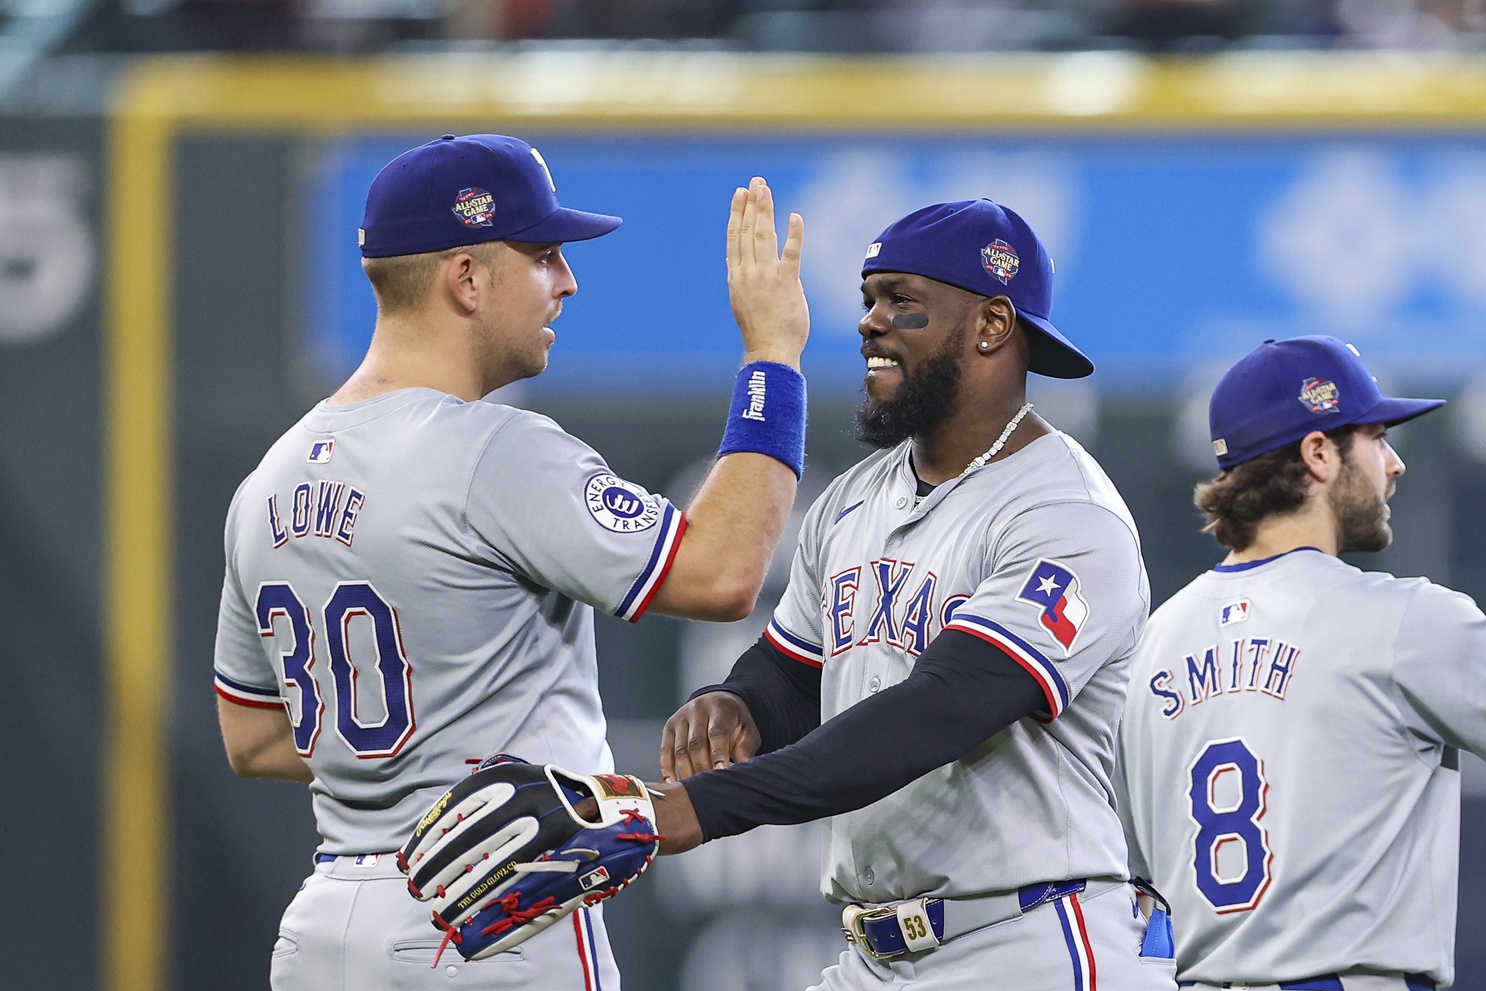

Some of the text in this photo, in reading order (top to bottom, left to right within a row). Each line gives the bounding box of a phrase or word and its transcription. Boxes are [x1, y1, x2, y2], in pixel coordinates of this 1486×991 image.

[463, 204, 489, 217] GAME
[990, 256, 1013, 271] GAME
[742, 370, 766, 422] Franklin
[266, 479, 365, 549] LOWE
[820, 557, 973, 658] EXA
[253, 579, 416, 759] 30
[1148, 635, 1301, 721] SMITH
[1185, 735, 1274, 915] 8
[469, 882, 489, 900] GOLD
[903, 914, 927, 941] 53
